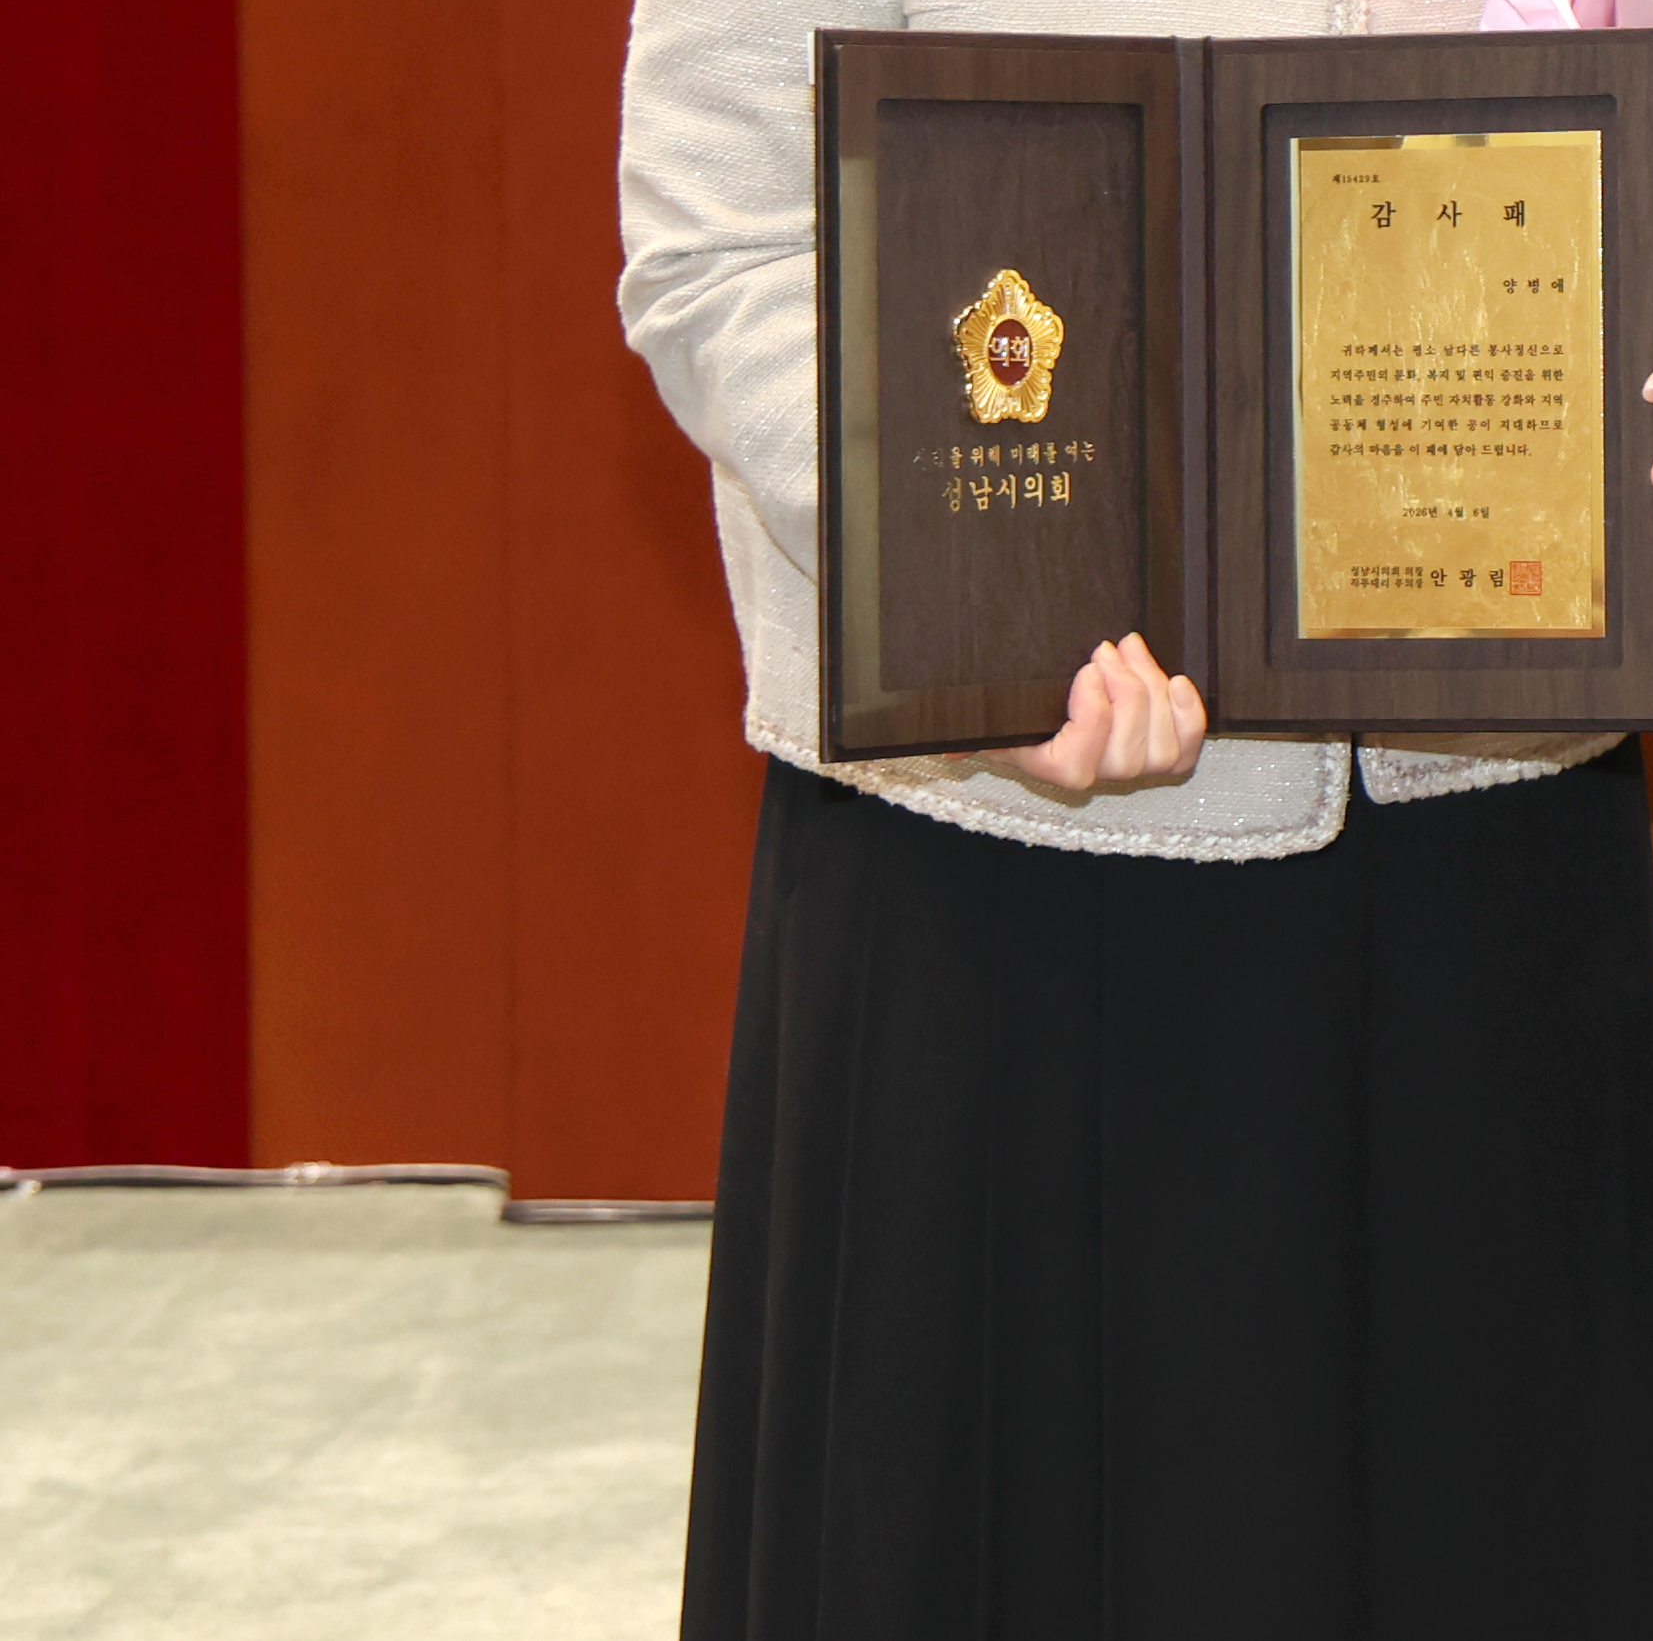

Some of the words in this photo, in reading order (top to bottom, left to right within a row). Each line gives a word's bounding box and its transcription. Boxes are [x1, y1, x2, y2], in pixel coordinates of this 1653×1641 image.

[989, 336, 1030, 367] 의회
[1412, 344, 1436, 356] 평소
[1444, 344, 1480, 356] 남다른
[1488, 344, 1564, 356] 봉사정신으로
[1331, 369, 1387, 381] 지역주민의
[1427, 369, 1449, 381] 복지
[1456, 369, 1466, 381] 및
[1501, 369, 1535, 381] 증진을
[1542, 369, 1564, 381] 위한
[1330, 394, 1364, 406] 노력을
[1421, 394, 1444, 406] 주민
[1449, 394, 1495, 406] 자치활동
[1501, 394, 1536, 406] 강화와
[1541, 394, 1563, 406] 지역
[1330, 419, 1367, 431] 공동체
[1421, 419, 1459, 431] 기여한
[1467, 419, 1490, 431] 공이
[1500, 419, 1563, 431] 지대하므로
[1064, 440, 1096, 463] 여는
[1330, 444, 1364, 456] 감사의
[1369, 444, 1404, 456] 마음을
[1409, 444, 1419, 456] 이
[1453, 444, 1476, 456] 담아
[1481, 444, 1532, 456] 드립니다.
[942, 470, 1072, 512] 성남시의회
[1402, 507, 1438, 518] 2026년
[1473, 507, 1490, 518] 6일
